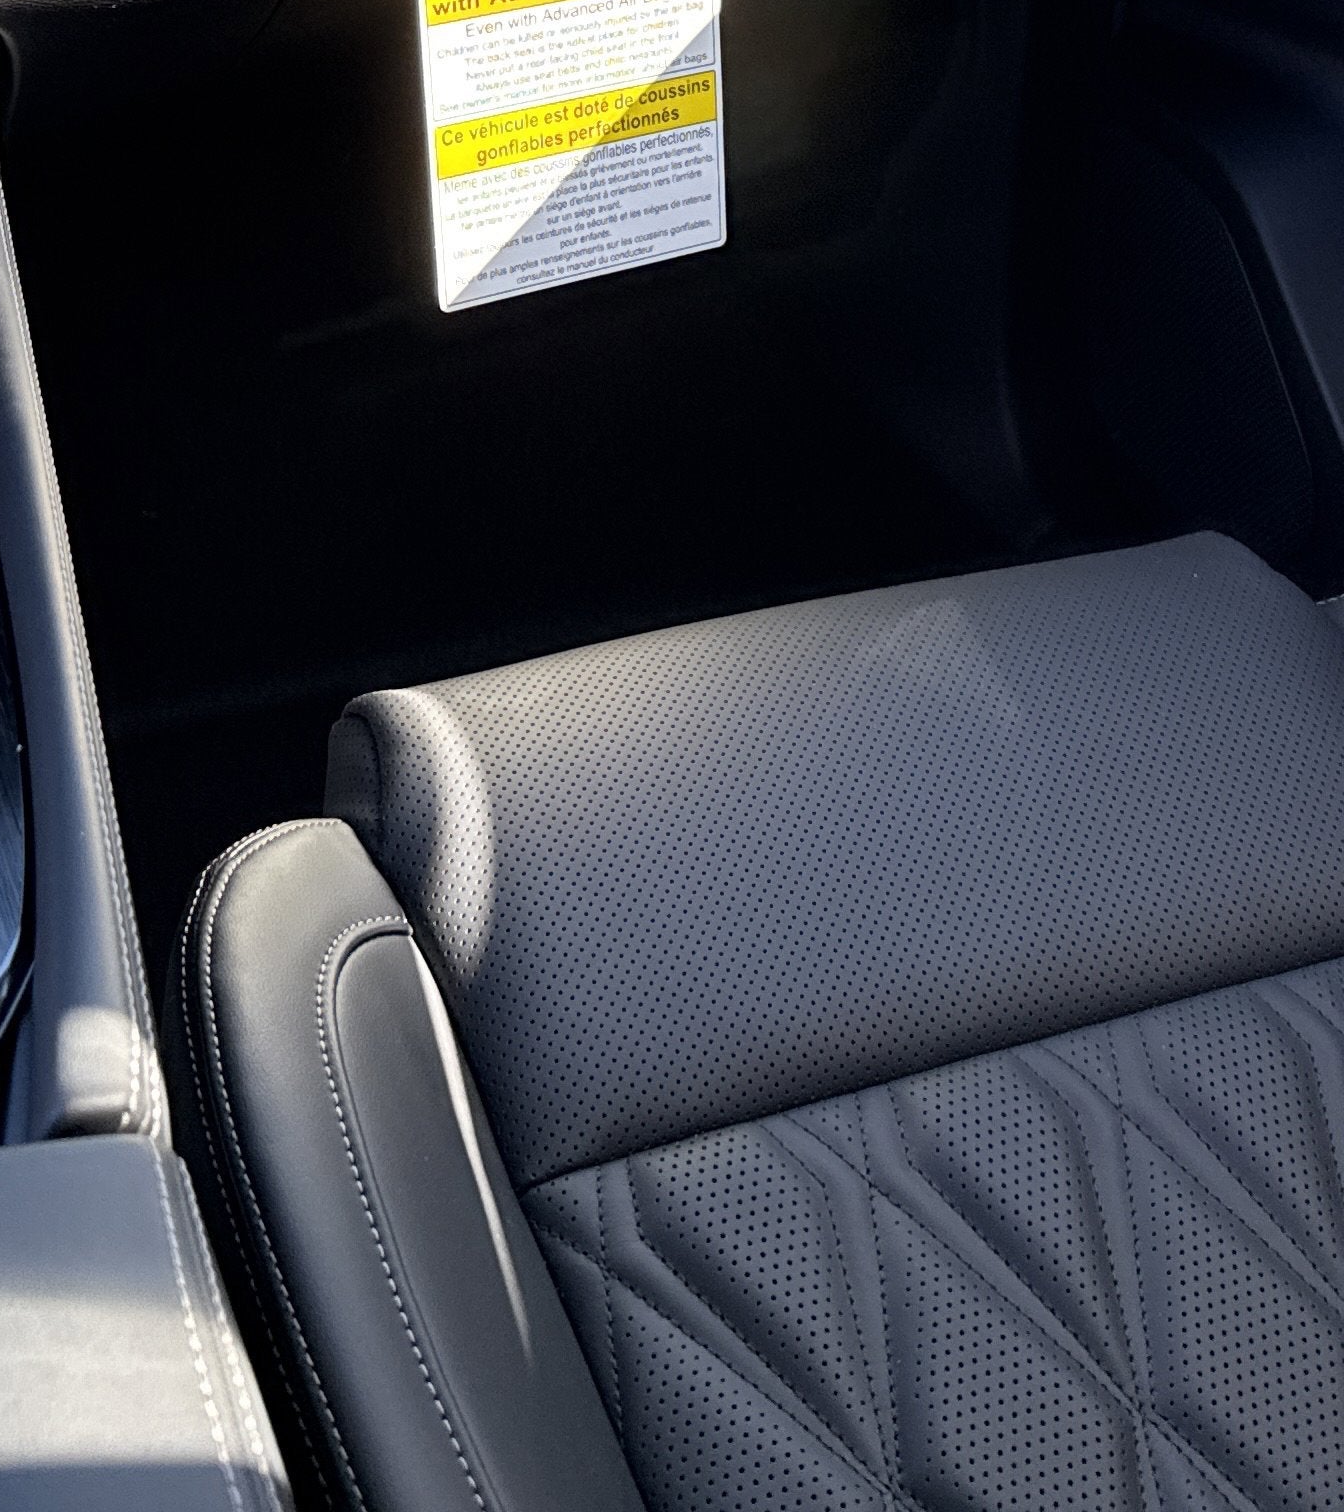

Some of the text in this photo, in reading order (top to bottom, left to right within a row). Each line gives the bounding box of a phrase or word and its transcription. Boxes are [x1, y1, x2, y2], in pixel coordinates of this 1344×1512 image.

[465, 17, 503, 37] Even
[507, 10, 536, 29] with
[684, 51, 707, 65] bags
[441, 75, 710, 146] Ce véhicule est doté de coussins
[476, 103, 679, 167] gonflables perfectionnés
[582, 140, 636, 166] gonflables
[640, 124, 713, 153] perfectionnés,
